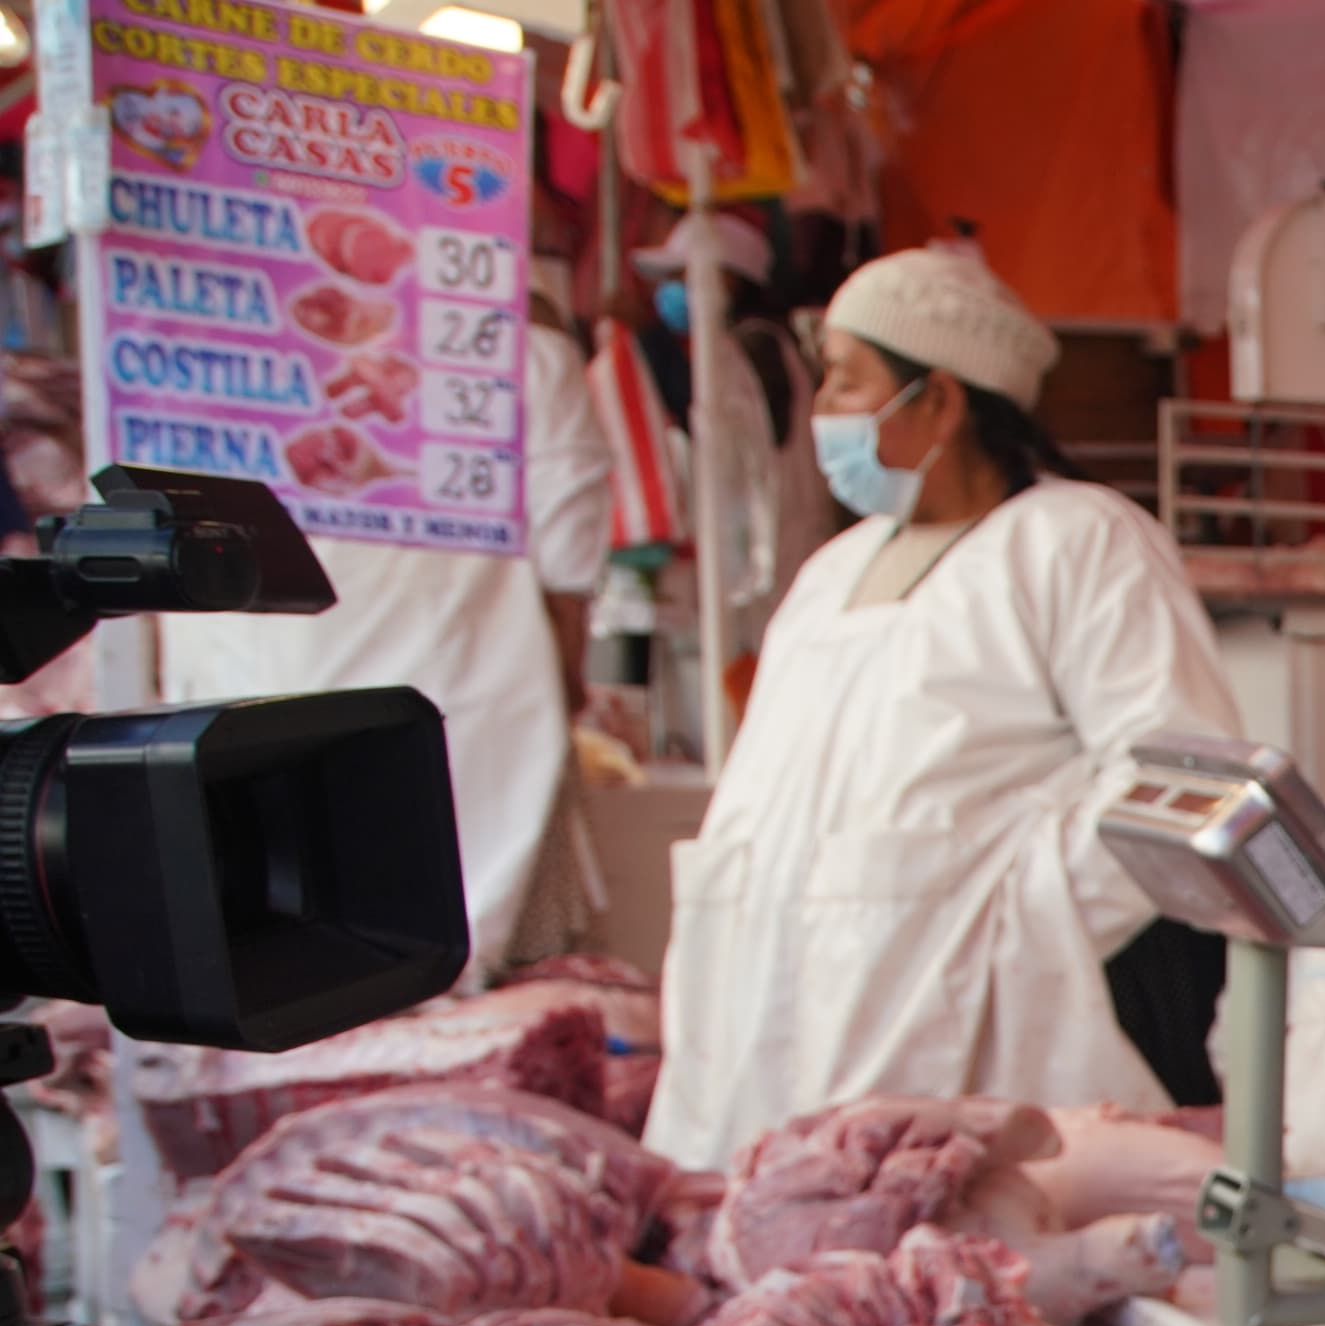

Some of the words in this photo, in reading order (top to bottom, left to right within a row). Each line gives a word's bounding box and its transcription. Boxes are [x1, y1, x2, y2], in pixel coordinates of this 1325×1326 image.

[94, 20, 267, 84] CORTES
[277, 57, 519, 133] ESPECIALES
[288, 18, 345, 55] DE
[355, 31, 493, 84] CERDO
[228, 91, 396, 146] CARLA
[233, 128, 394, 180] CASAS
[448, 165, 476, 206] 5
[109, 178, 299, 251] CHULETA
[437, 236, 495, 290] 30
[113, 255, 272, 326] PALETA
[112, 340, 310, 406] COSTILLA
[444, 378, 492, 429] 32
[123, 416, 280, 478] PIERNA
[439, 452, 494, 499] 28
